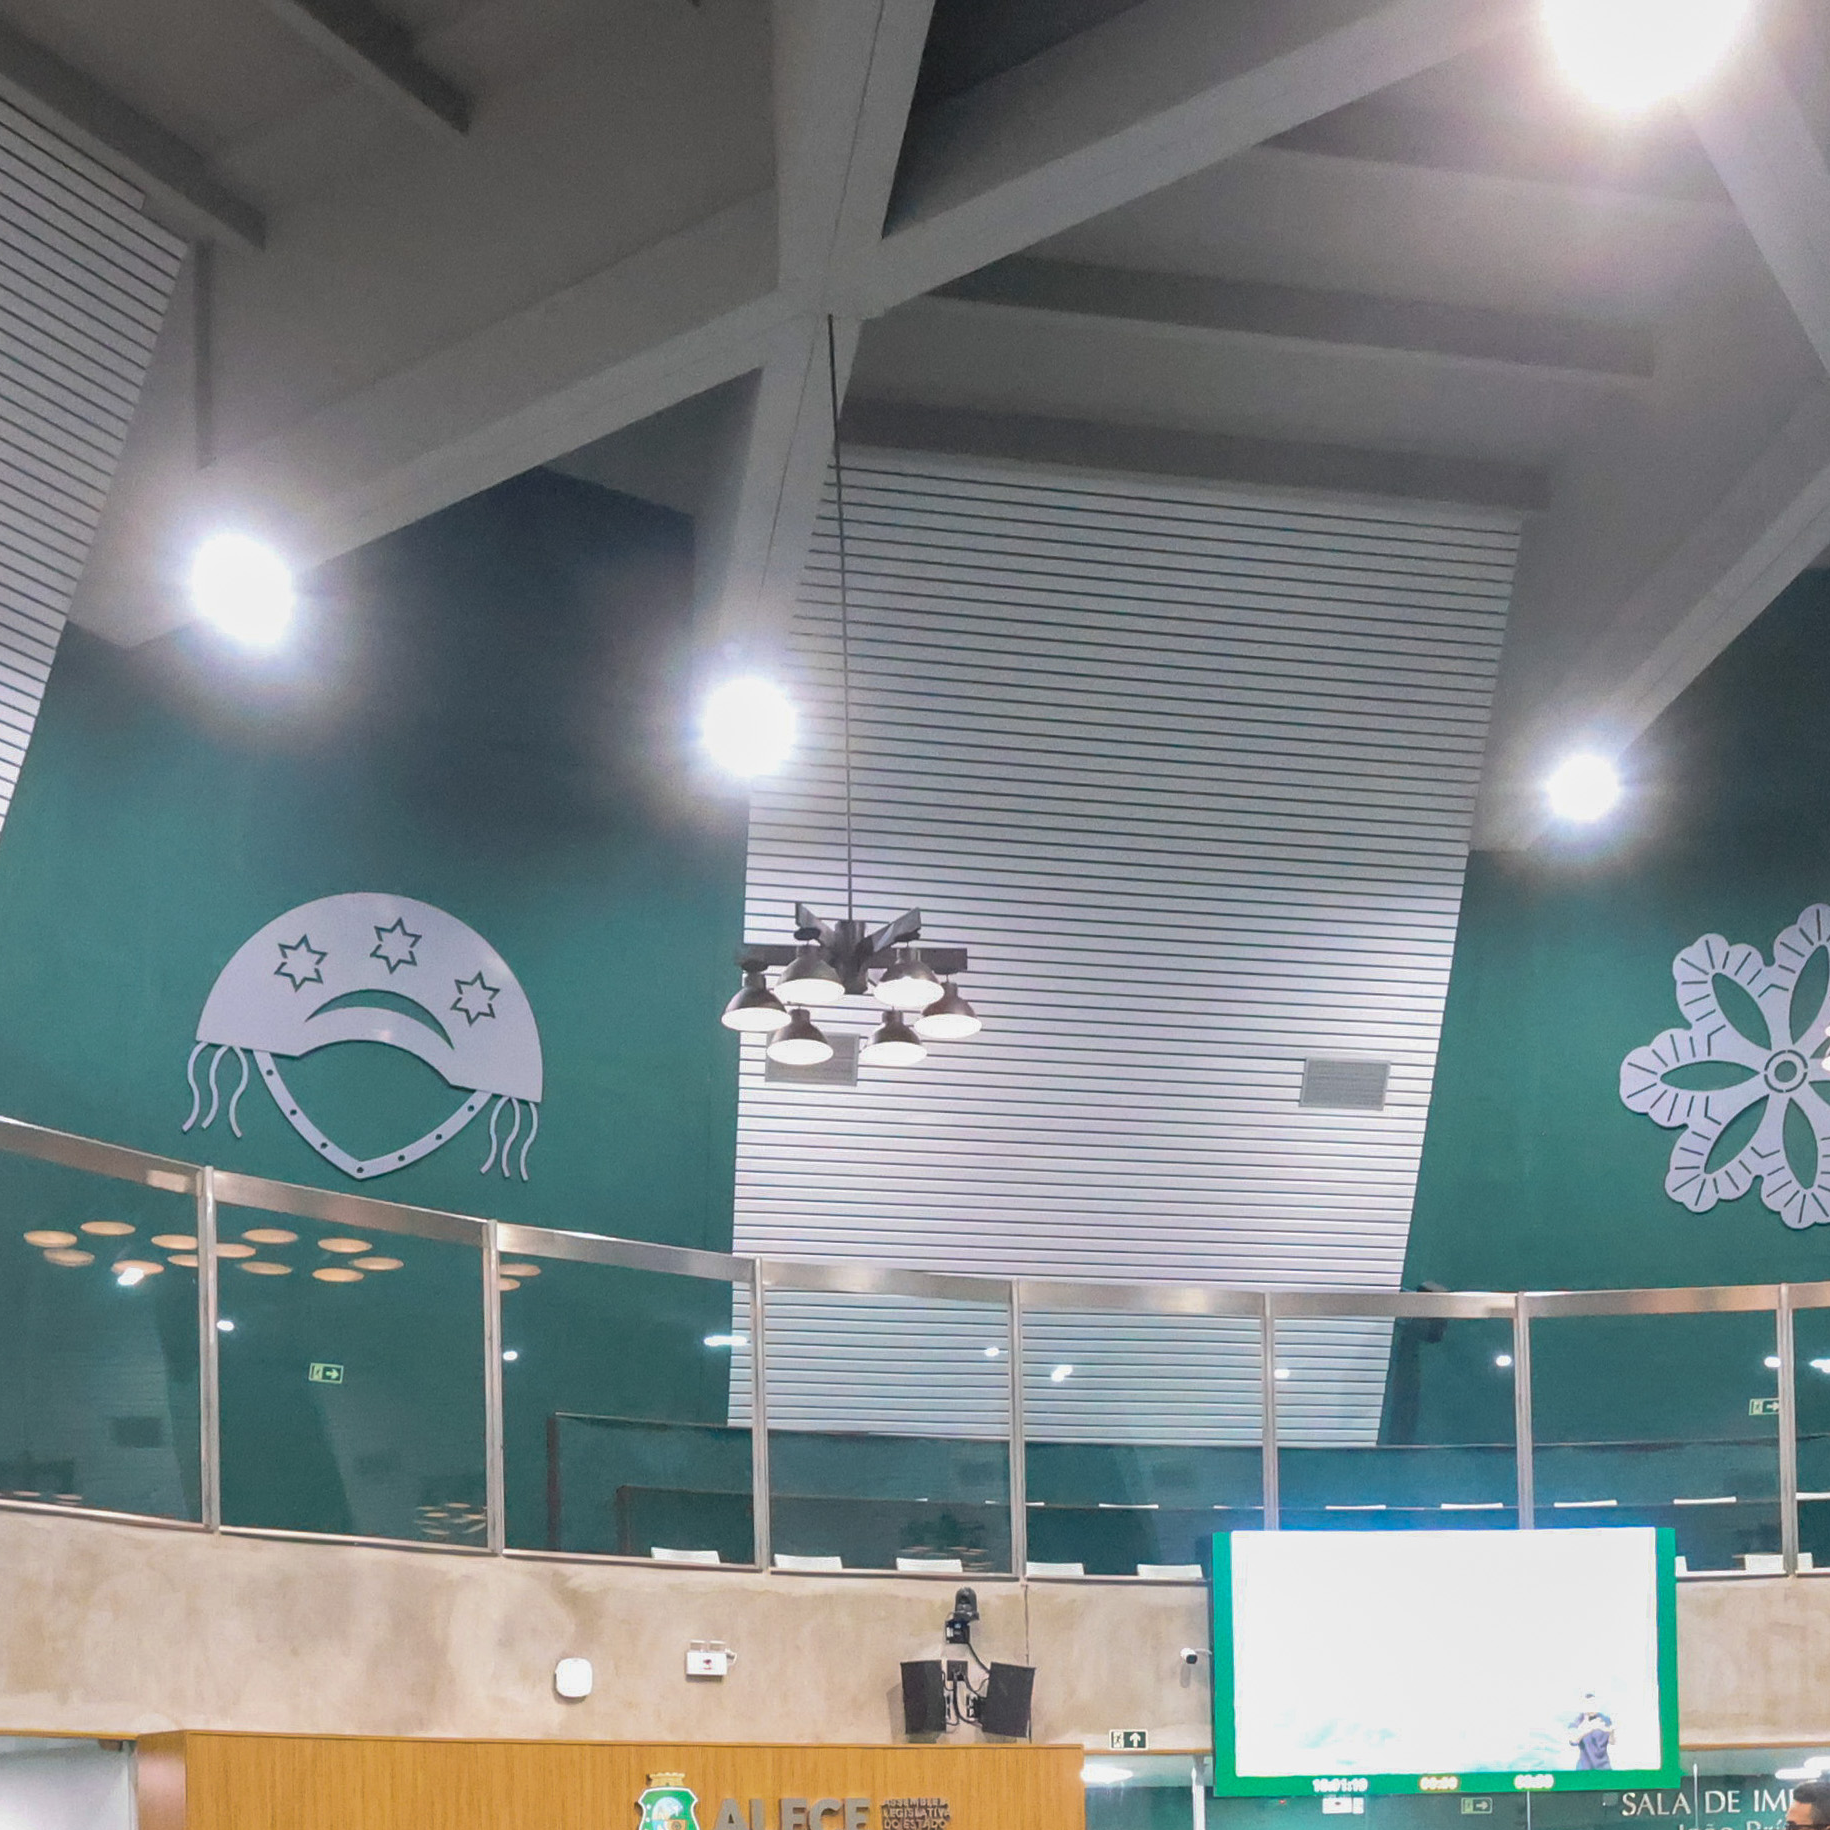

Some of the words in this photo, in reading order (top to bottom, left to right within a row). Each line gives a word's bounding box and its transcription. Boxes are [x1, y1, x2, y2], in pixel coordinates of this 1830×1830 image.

[1622, 1792, 1691, 1816] SALA
[1705, 1790, 1741, 1814] DE
[884, 1819, 900, 1829] DO
[903, 1819, 947, 1830] ESTADO
